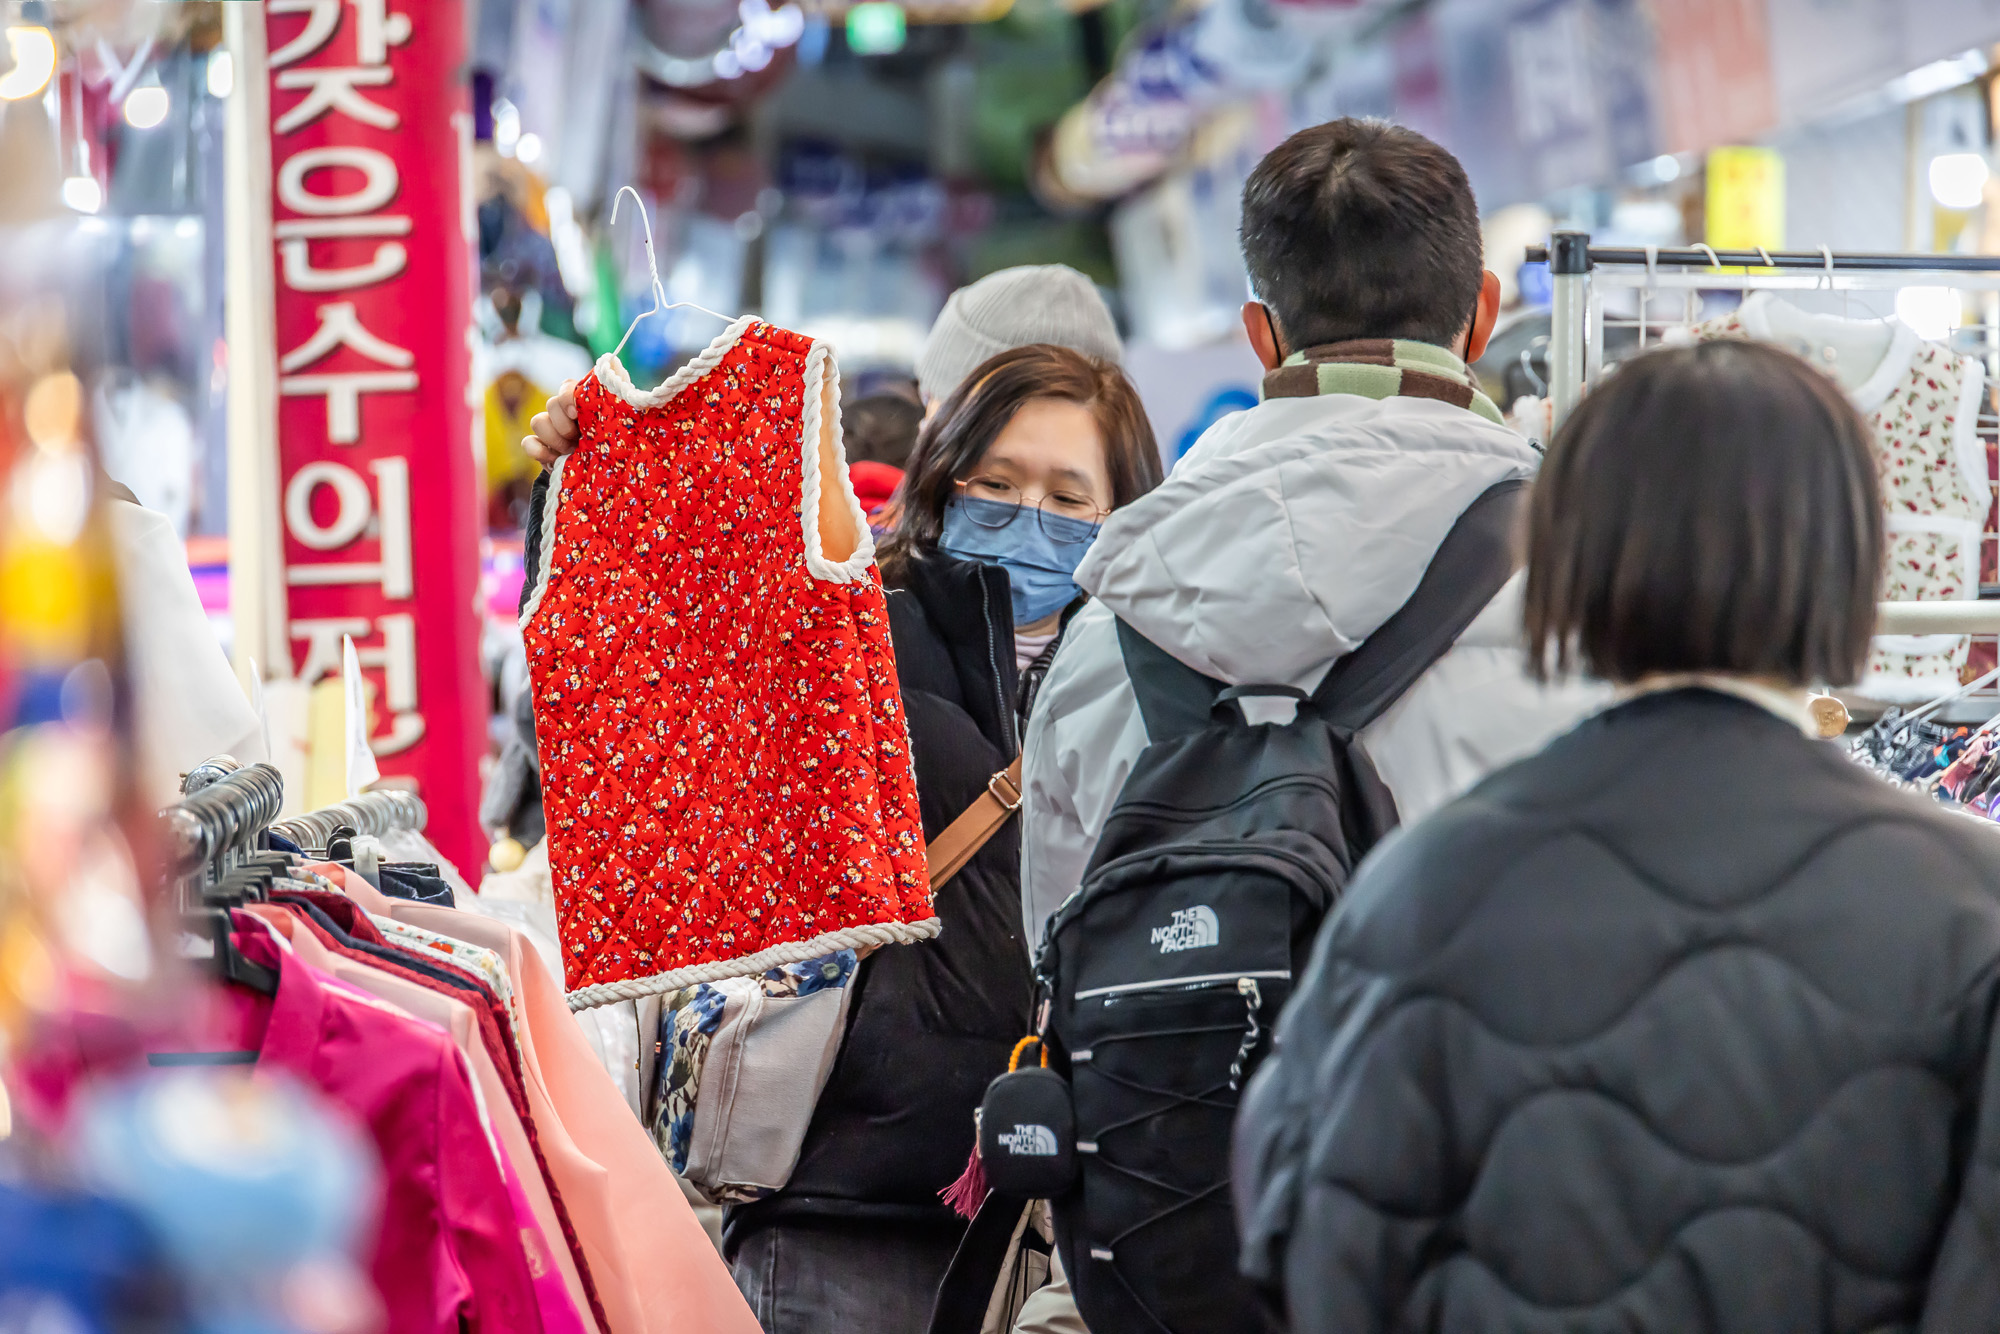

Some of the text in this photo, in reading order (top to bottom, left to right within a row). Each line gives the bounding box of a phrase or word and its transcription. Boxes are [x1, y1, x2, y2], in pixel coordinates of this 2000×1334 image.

[1171, 909, 1197, 926] THE
[1151, 921, 1195, 944] NORTH
[1160, 935, 1196, 954] FACE
[1014, 1124, 1036, 1135] THE
[998, 1134, 1036, 1145] NORTH
[1009, 1144, 1036, 1154] FACE
